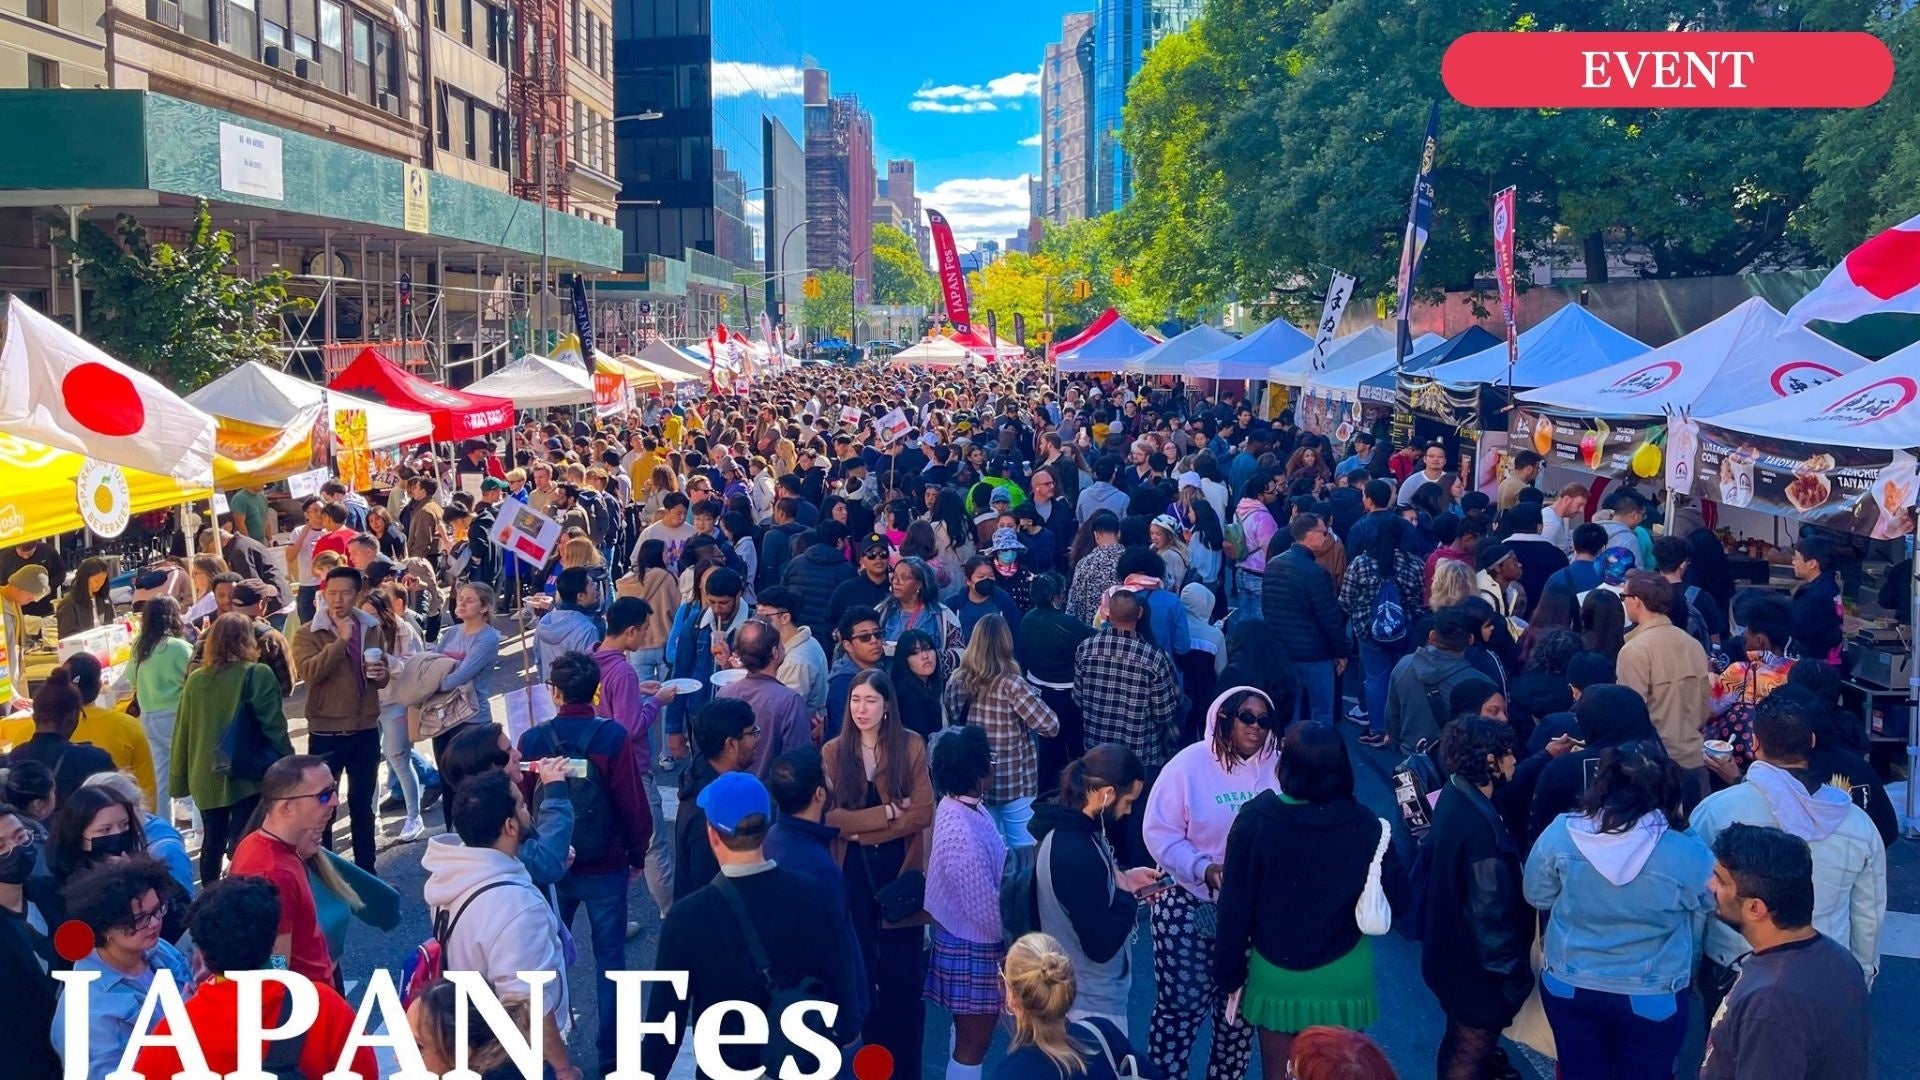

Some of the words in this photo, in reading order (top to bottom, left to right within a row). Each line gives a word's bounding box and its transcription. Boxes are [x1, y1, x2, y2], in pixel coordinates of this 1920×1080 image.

[944, 250, 956, 271] Fes
[947, 273, 965, 313] JAPAN
[87, 500, 128, 534] BEVERAGES
